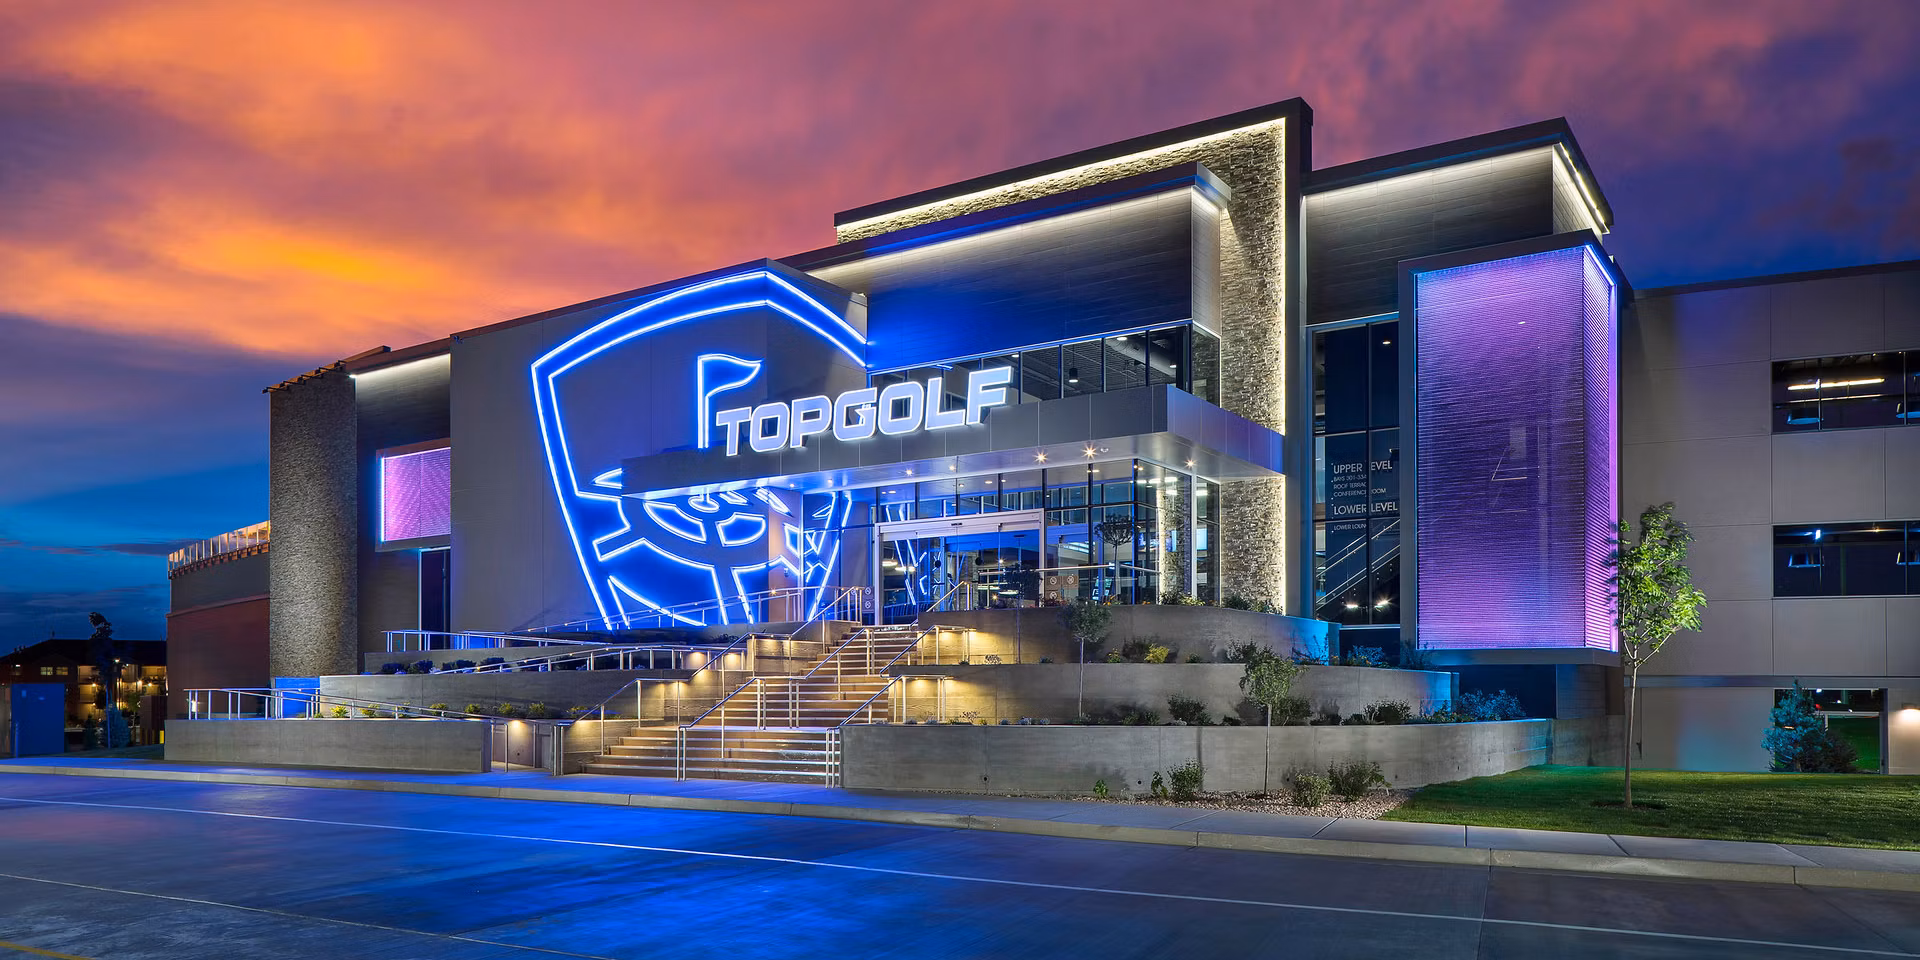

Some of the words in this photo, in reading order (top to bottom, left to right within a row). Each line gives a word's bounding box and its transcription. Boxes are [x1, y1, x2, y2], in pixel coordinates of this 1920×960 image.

[715, 365, 1014, 457] TOPGOLF
[1333, 463, 1363, 474] UPPER
[1370, 460, 1393, 470] EVEL
[1333, 504, 1367, 515] LOWER
[1370, 502, 1398, 513] LEVEL
